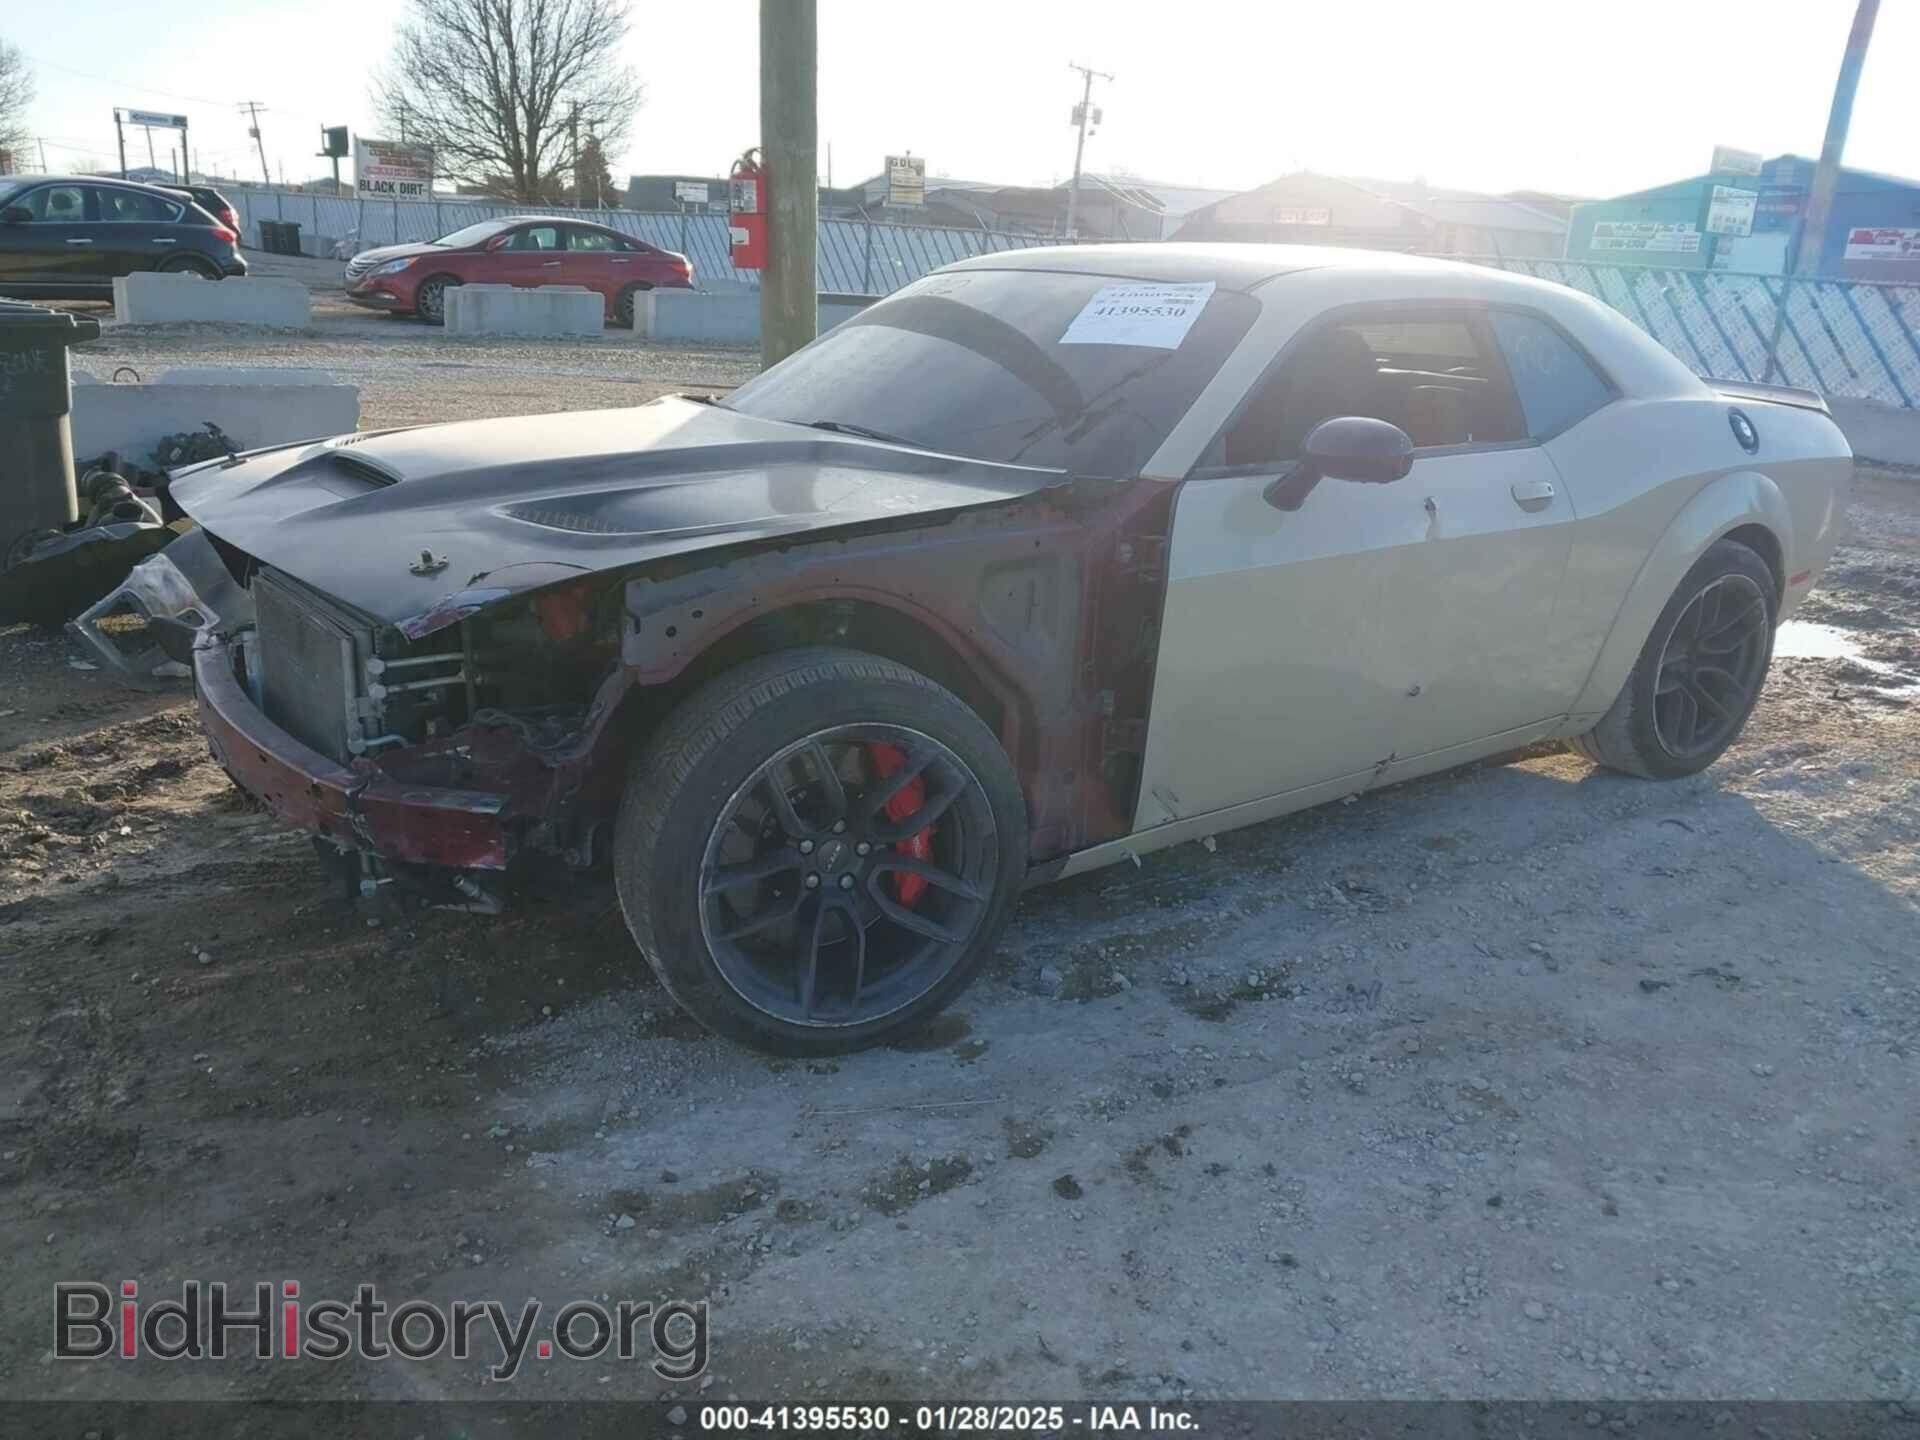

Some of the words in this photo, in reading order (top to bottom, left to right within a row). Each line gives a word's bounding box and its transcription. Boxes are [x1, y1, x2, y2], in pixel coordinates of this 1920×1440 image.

[359, 179, 396, 193] BLACK
[399, 183, 424, 195] DIRT
[1093, 305, 1187, 318] 41395530
